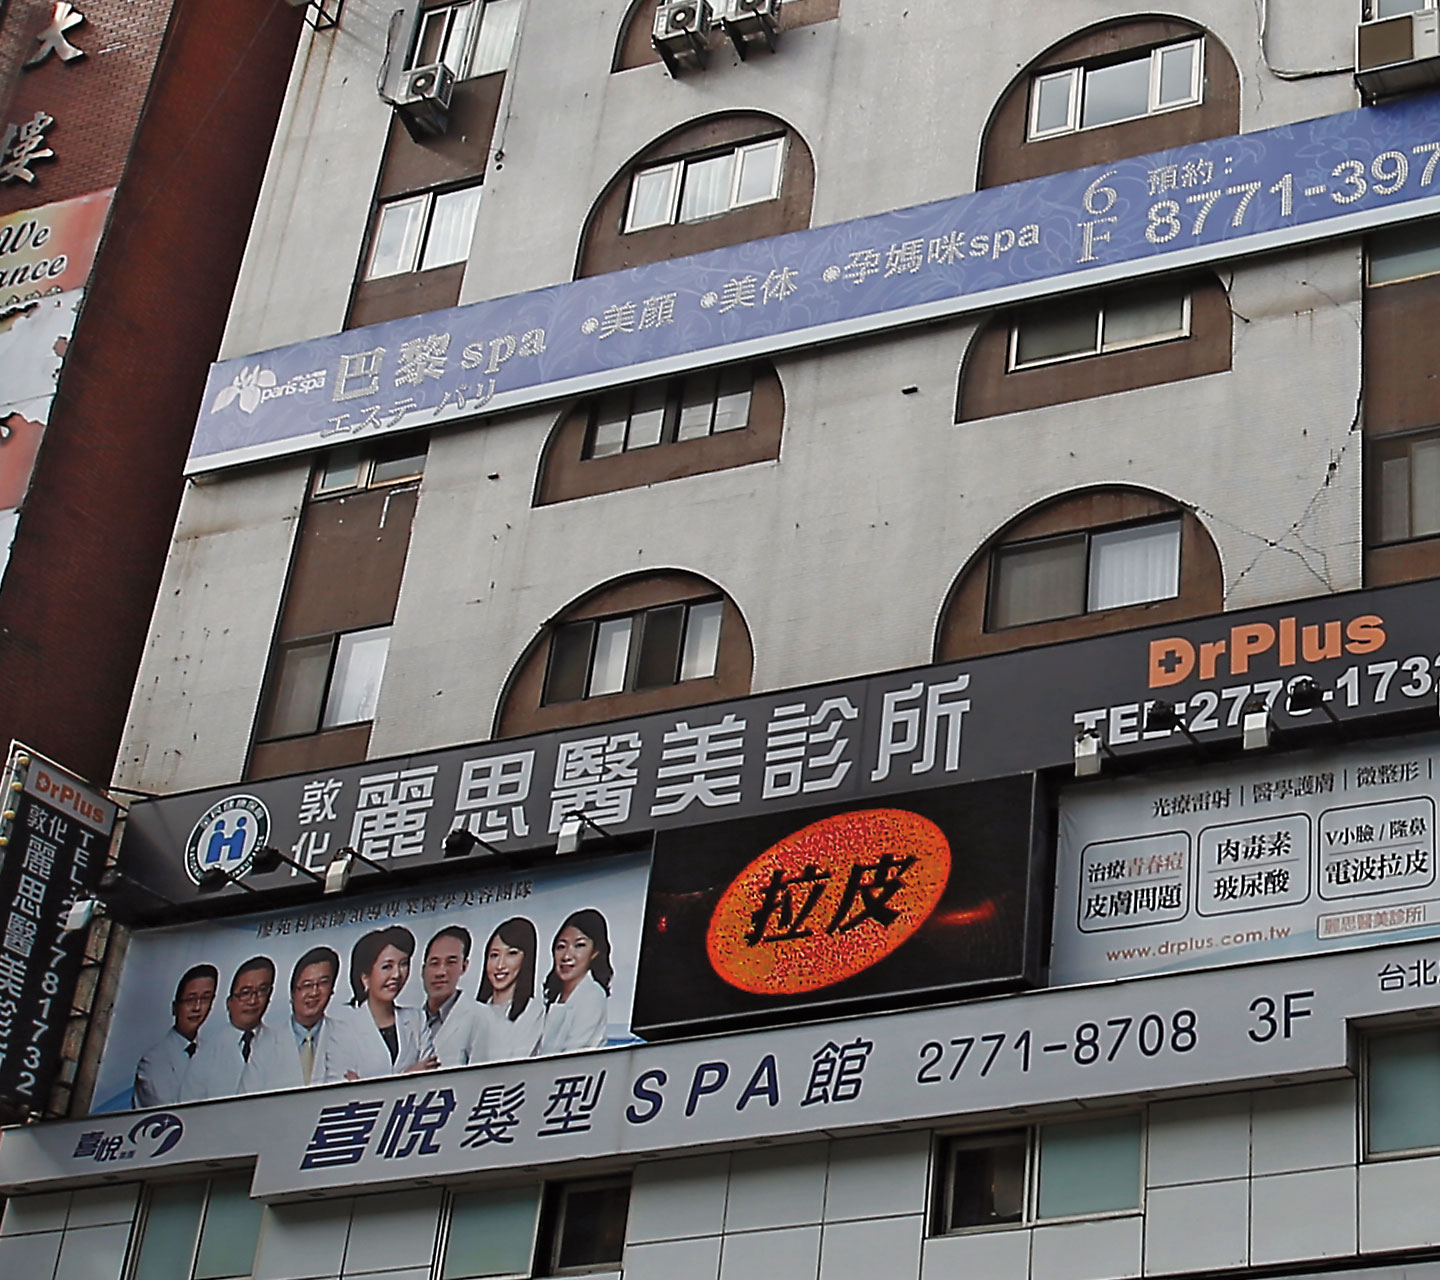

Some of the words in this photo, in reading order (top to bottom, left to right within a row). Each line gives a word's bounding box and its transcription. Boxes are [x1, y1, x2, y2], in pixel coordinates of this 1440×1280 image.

[460, 326, 548, 376] spa
[1148, 614, 1387, 689] DrPlus
[36, 770, 106, 825] DrPlus
[291, 777, 344, 878] 敦化
[349, 674, 972, 862] 麗思醫美診所
[1216, 831, 1292, 865] 肉毒素
[1324, 849, 1429, 886] 電波拉皮
[746, 851, 919, 944] 拉皮
[1085, 881, 1182, 920] 皮膚問題
[1213, 867, 1290, 902] 玻尿酸
[1105, 924, 1292, 963] www.drplus.com.tw
[917, 1010, 1198, 1086] 2771-8708
[1246, 991, 1317, 1047] 3F
